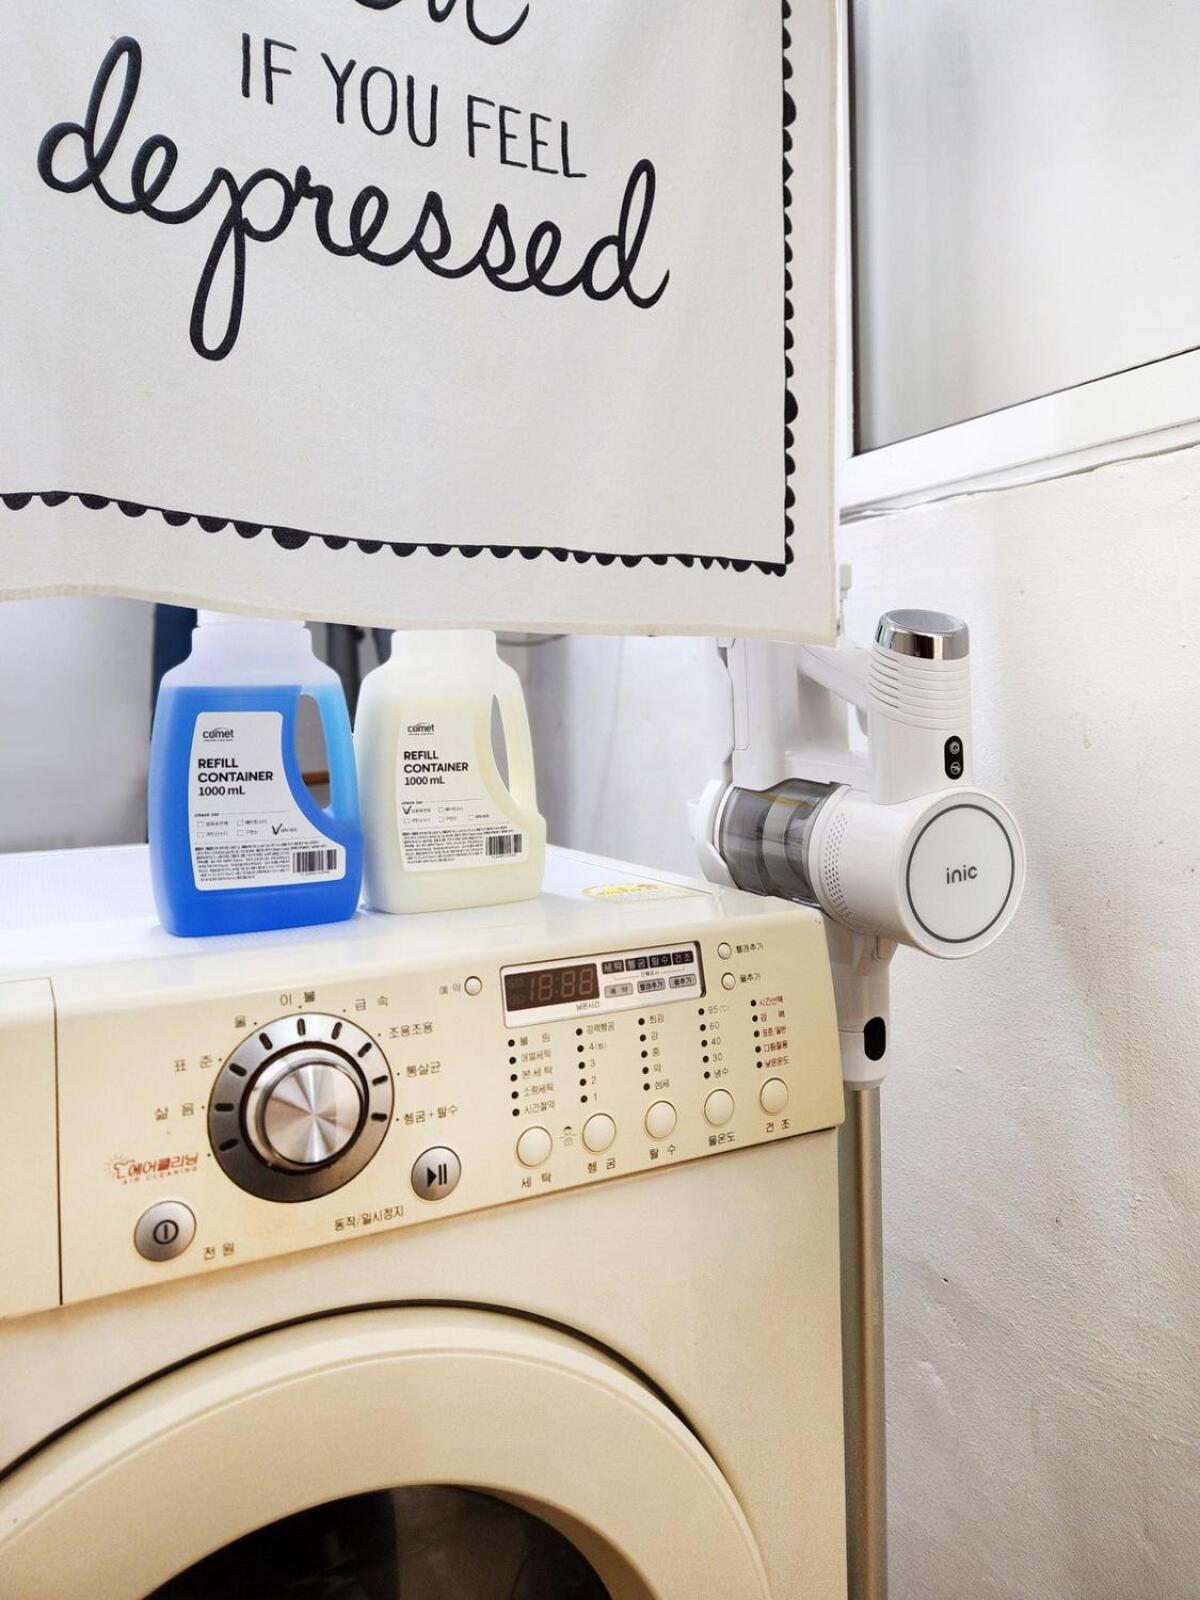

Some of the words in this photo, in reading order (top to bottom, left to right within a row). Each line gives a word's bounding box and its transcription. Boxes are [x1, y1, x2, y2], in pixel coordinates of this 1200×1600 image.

[241, 32, 297, 104] IF
[321, 52, 438, 147] YOU
[468, 94, 587, 178] FEEL
[37, 36, 670, 361] depressed
[407, 723, 435, 733] comet
[202, 728, 234, 740] comet
[404, 750, 439, 760] REFILL
[198, 758, 238, 769] REFILL
[404, 762, 469, 774] CONTAINER
[197, 771, 273, 783] CONTAINER
[405, 777, 428, 786] 1000
[430, 776, 445, 785] mL
[199, 786, 226, 797] 1000
[227, 785, 245, 796] mL
[946, 864, 978, 884] inic
[389, 1021, 433, 1039] 조용조용
[709, 1021, 720, 1030] 60
[711, 1037, 721, 1045] 40
[712, 1053, 723, 1062] 30
[590, 1059, 595, 1068] 3
[406, 1061, 441, 1078] 통살균
[592, 1076, 596, 1084] 2
